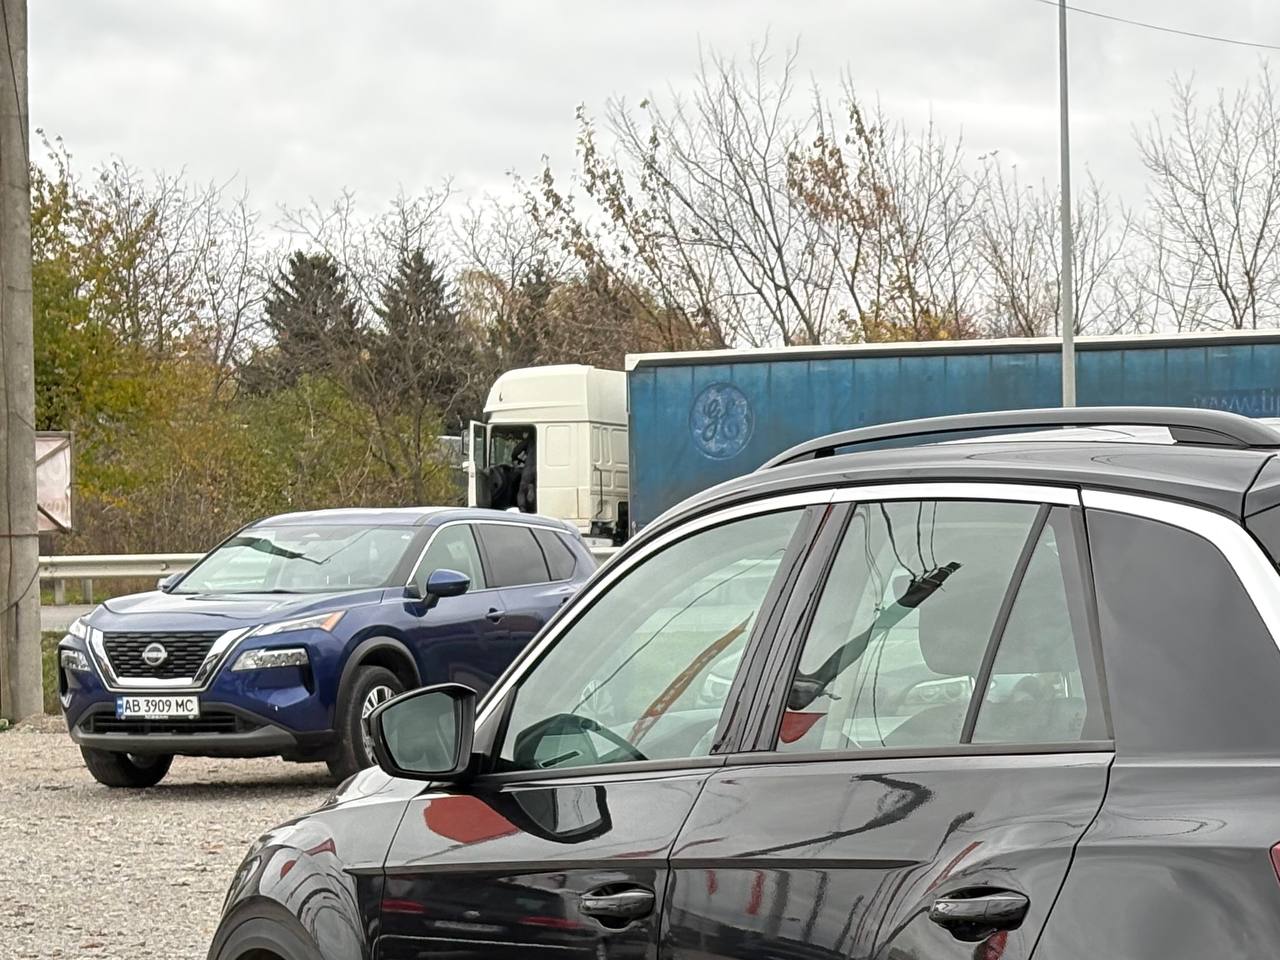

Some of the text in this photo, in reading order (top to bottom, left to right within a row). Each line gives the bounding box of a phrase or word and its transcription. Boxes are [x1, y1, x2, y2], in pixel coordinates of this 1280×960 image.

[124, 699, 194, 713] AB 3909 MC
